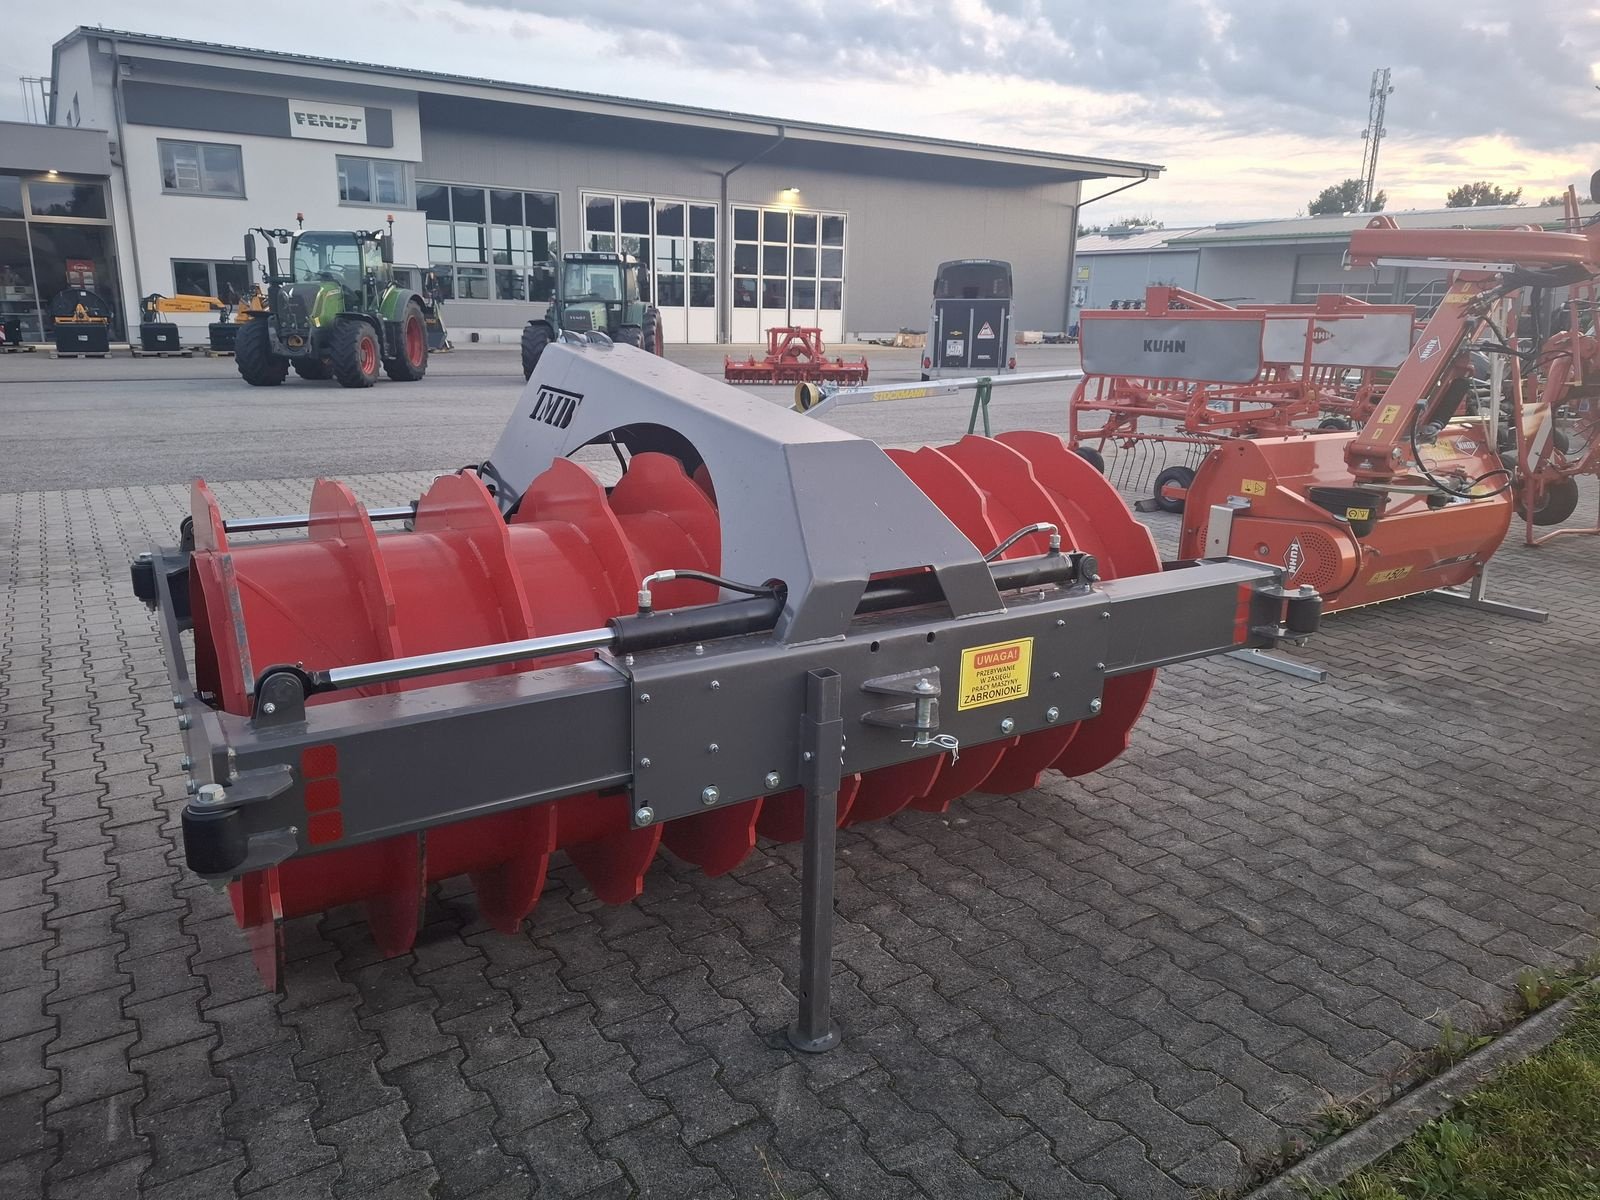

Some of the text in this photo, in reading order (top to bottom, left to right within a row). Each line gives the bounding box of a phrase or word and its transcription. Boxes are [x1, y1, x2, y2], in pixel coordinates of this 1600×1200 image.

[294, 111, 362, 131] FENDT
[1143, 339, 1186, 353] KUHN
[872, 387, 928, 402] STOCKMANN
[1288, 543, 1300, 574] KUHN
[977, 650, 1017, 665] UWAGA!
[976, 664, 1016, 677] PRZEBYWANIE
[972, 679, 1018, 693] PRACY MASZYNY
[964, 684, 1022, 704] ZABRONIONE
